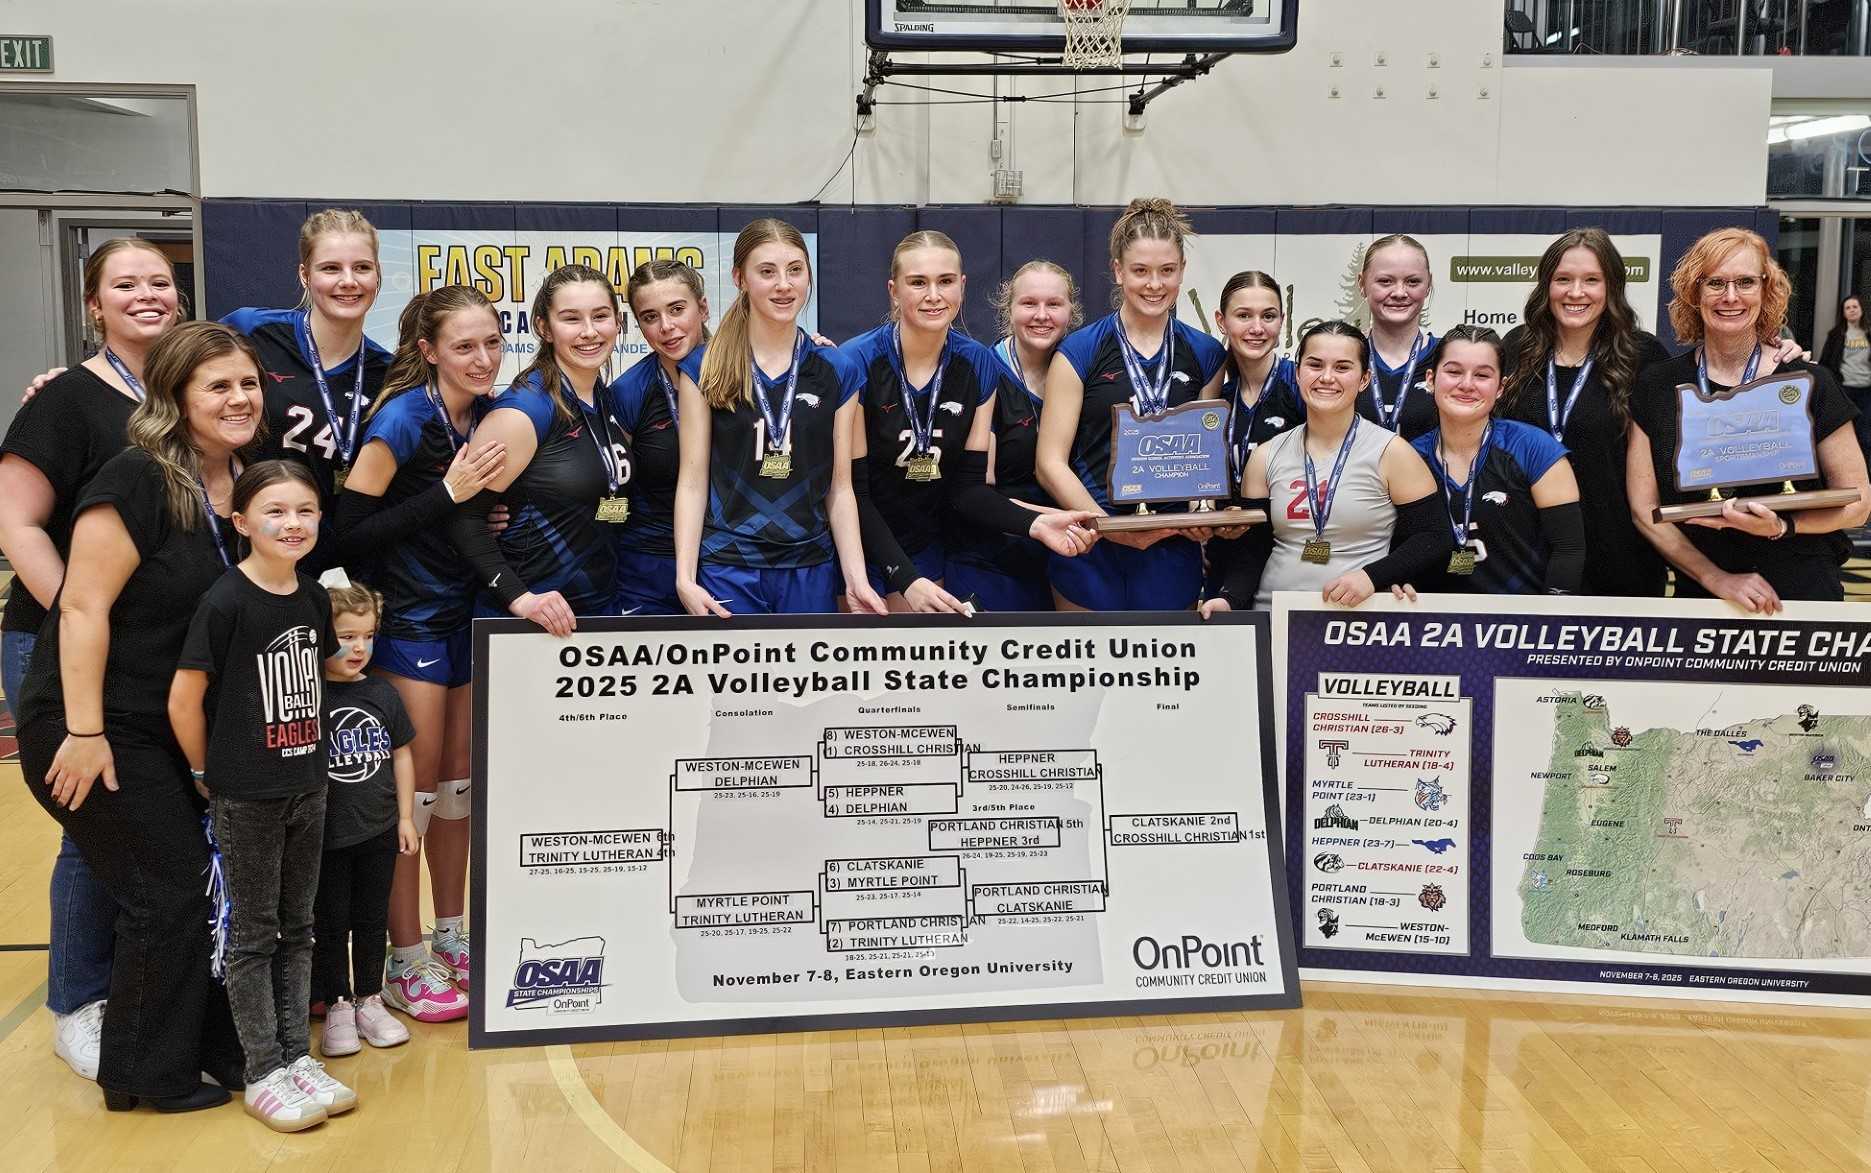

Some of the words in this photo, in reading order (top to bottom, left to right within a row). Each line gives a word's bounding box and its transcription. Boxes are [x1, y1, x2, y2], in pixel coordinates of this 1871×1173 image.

[894, 23, 934, 33] SPALDING
[0, 40, 41, 68] EXIT
[417, 244, 529, 303] EAST
[1464, 309, 1517, 324] Home
[282, 405, 344, 460] 24
[1139, 433, 1201, 457] OSAA
[1149, 463, 1211, 472] VOLLEYBALL
[1153, 471, 1189, 479] CHAMPION
[1287, 479, 1329, 520] 21
[1324, 620, 1411, 647] OSAA
[1420, 622, 1463, 648] 2A
[1475, 623, 1685, 655] VOLLEYBALL
[1694, 627, 1801, 658] STATE
[559, 643, 796, 668] OSAA/OnPoint
[810, 639, 988, 665] Community
[1001, 639, 1096, 660] Credit
[1108, 638, 1197, 660] Union
[1527, 654, 1602, 666] PRESENTED
[1606, 655, 1622, 666] BY
[1625, 656, 1683, 668] ONPOINT
[1685, 658, 1766, 670] COMMUNITY
[1768, 660, 1817, 672] CREDIT
[1818, 661, 1862, 673] UNION
[555, 675, 637, 698] 2025
[651, 674, 694, 695] 2A
[708, 670, 870, 698] Volleyball
[884, 669, 968, 690] State
[981, 667, 1200, 692] Championship
[1324, 678, 1456, 698] VOLLEYBALL
[284, 693, 313, 710] BALL
[1536, 696, 1577, 704] ASTORIA
[858, 705, 921, 714] Quarterfinals
[1006, 703, 1055, 712] Semifinals
[1156, 703, 1179, 711] Final
[559, 713, 595, 722] 4th/6th
[599, 712, 628, 721] Place
[715, 709, 773, 718] Consolation
[1312, 712, 1371, 722] CROSSHILL
[265, 718, 319, 749] EAGLES
[844, 729, 954, 739] WESTON-MCEWEN
[1312, 723, 1369, 734] CHRISTIAN
[1696, 729, 1711, 737] THE
[1713, 730, 1748, 738] DALLES
[329, 726, 392, 758] AGLES
[844, 745, 914, 755] CROSSHILL
[1409, 749, 1451, 758] TRINITY
[999, 752, 1055, 763] HEPPNER
[685, 759, 800, 772] WESTON-MCEWEN
[1364, 760, 1420, 769] LUTHERAN
[1587, 764, 1617, 772] SALEM
[969, 768, 1037, 780] CROSSHILL
[1040, 766, 1102, 778] CHRISTIAN
[1530, 772, 1572, 780] NEWPORT
[1804, 774, 1833, 782] BAKER
[714, 776, 778, 787] DELPHIAN
[1312, 780, 1354, 789] MYRTLE
[846, 786, 904, 797] HEPPNER
[1312, 792, 1344, 801] POINT
[846, 802, 907, 813] DELPHIAN
[971, 803, 1006, 812] 3rd/5th
[1009, 803, 1035, 811] Place
[930, 820, 996, 832] PORTLAND
[999, 818, 1063, 830] CHRISTIAN
[1066, 818, 1084, 829] 5th
[1131, 816, 1206, 827] CLATSKANIE
[1210, 815, 1231, 825] 2nd
[1314, 817, 1359, 831] DELPHIAN
[1368, 816, 1421, 827] DELPHIAN
[1591, 820, 1624, 828] EUGENE
[1853, 824, 1871, 832] ONT
[531, 833, 651, 847] WESTON-MCEWEN
[961, 836, 1018, 847] HEPPNER
[1021, 835, 1040, 846] 3rd
[1113, 832, 1183, 844] CROSSHILL
[1184, 830, 1247, 842] CHRISTIAN
[1248, 829, 1265, 840] 1st
[1311, 837, 1361, 847] HEPPNER
[529, 851, 579, 863] TRINITY
[583, 848, 653, 861] LUTHERAN
[1523, 853, 1545, 861] COOS
[847, 859, 925, 871] CLATSKANIE
[1357, 862, 1422, 872] CLATSKANIE
[1566, 869, 1612, 878] ROSEBURG
[847, 876, 897, 888] MYRTLE
[901, 875, 939, 886] POINT
[974, 885, 1040, 897] PORTLAND
[1043, 884, 1109, 895] CHRISTIAN
[1311, 883, 1367, 893] PORTLAND
[696, 896, 747, 908] MYRTLE
[751, 894, 790, 906] POINT
[1311, 895, 1367, 905] CHRISTIAN
[997, 900, 1073, 913] CLATSKANIE
[682, 914, 731, 926] TRINITY
[735, 910, 804, 923] LUTHERAN
[849, 917, 917, 931] PORTLAND
[1400, 922, 1450, 932] WESTON-
[1577, 923, 1619, 932] MEDFORD
[828, 938, 843, 949] (2)
[850, 936, 898, 948] TRINITY
[901, 933, 968, 946] LUTHERAN
[1365, 932, 1412, 943] McEWEN
[1620, 933, 1661, 942] KLAMATH
[1663, 935, 1689, 943] FALLS
[1133, 934, 1265, 970] OnPoint
[514, 956, 604, 989] OSAA
[713, 972, 800, 987] November
[806, 969, 839, 984] 7-8,
[846, 967, 912, 981] Eastern
[919, 964, 980, 979] Oregon
[987, 959, 1073, 976] University
[1135, 974, 1195, 988] COMMUNITY
[1198, 973, 1232, 985] CREDIT
[1235, 971, 1267, 983] UNION
[1599, 970, 1643, 981] NOVEMBER
[1661, 974, 1682, 982] 2025
[1689, 975, 1726, 984] EASTERN
[1727, 977, 1760, 986] OREGON
[1760, 978, 1809, 988] UNIVERSITY
[513, 990, 536, 998] STATE
[537, 986, 599, 997] CHAMPIONSHIPS
[553, 999, 590, 1009] OnPoint
